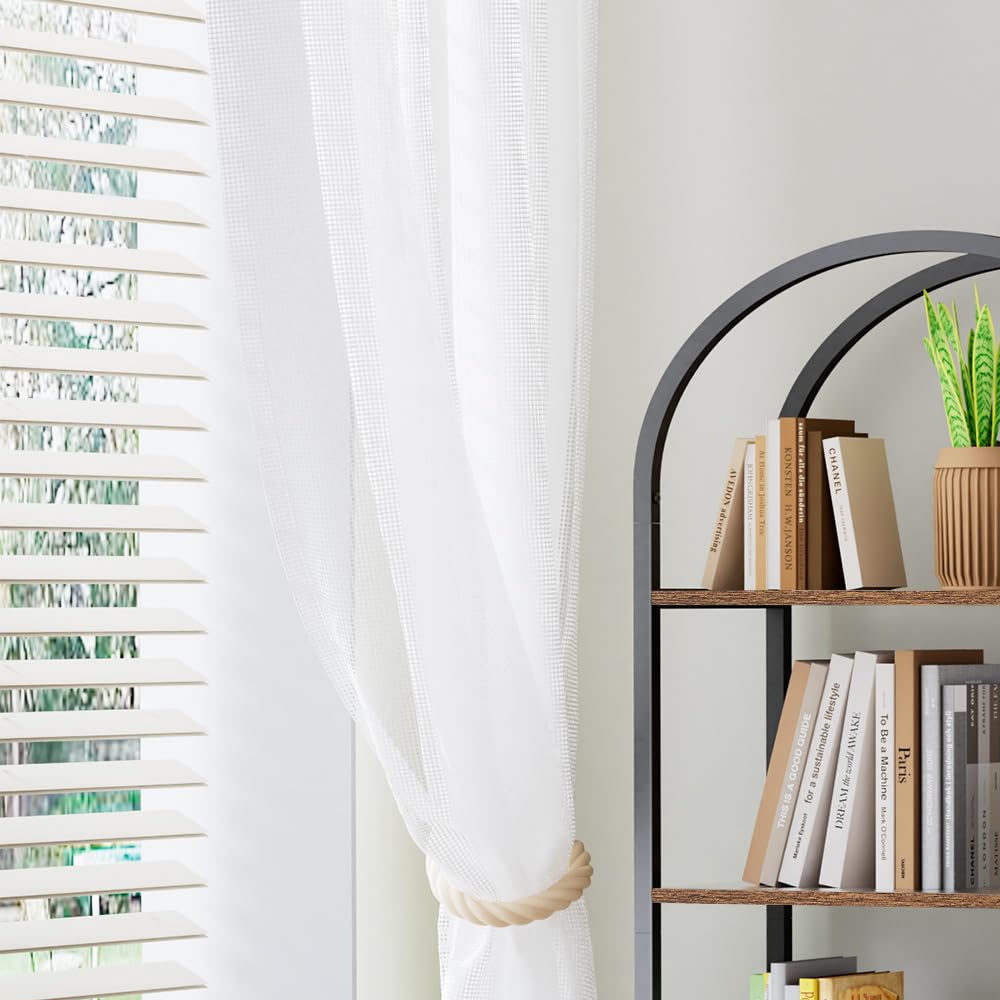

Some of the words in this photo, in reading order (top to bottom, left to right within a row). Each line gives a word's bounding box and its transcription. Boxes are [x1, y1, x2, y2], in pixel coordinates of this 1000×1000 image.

[724, 469, 737, 506] AVEDON
[784, 448, 792, 497] KONSTEN
[828, 447, 843, 495] CHANEL
[710, 508, 727, 553] advertising
[797, 712, 812, 749] GUIDE
[847, 711, 861, 751] AWAKE
[880, 714, 889, 725] To
[880, 729, 889, 744] Be
[804, 790, 814, 804] for
[811, 722, 830, 780] sustainable
[823, 682, 841, 721] lifestyle
[846, 750, 855, 773] world
[788, 749, 802, 781] GOOD
[842, 772, 850, 787] the
[880, 756, 889, 801] Machine
[898, 747, 911, 784] Paris
[783, 793, 792, 805] IS
[786, 783, 795, 792] A
[777, 806, 789, 829] THIS
[835, 788, 850, 829] DREAM
